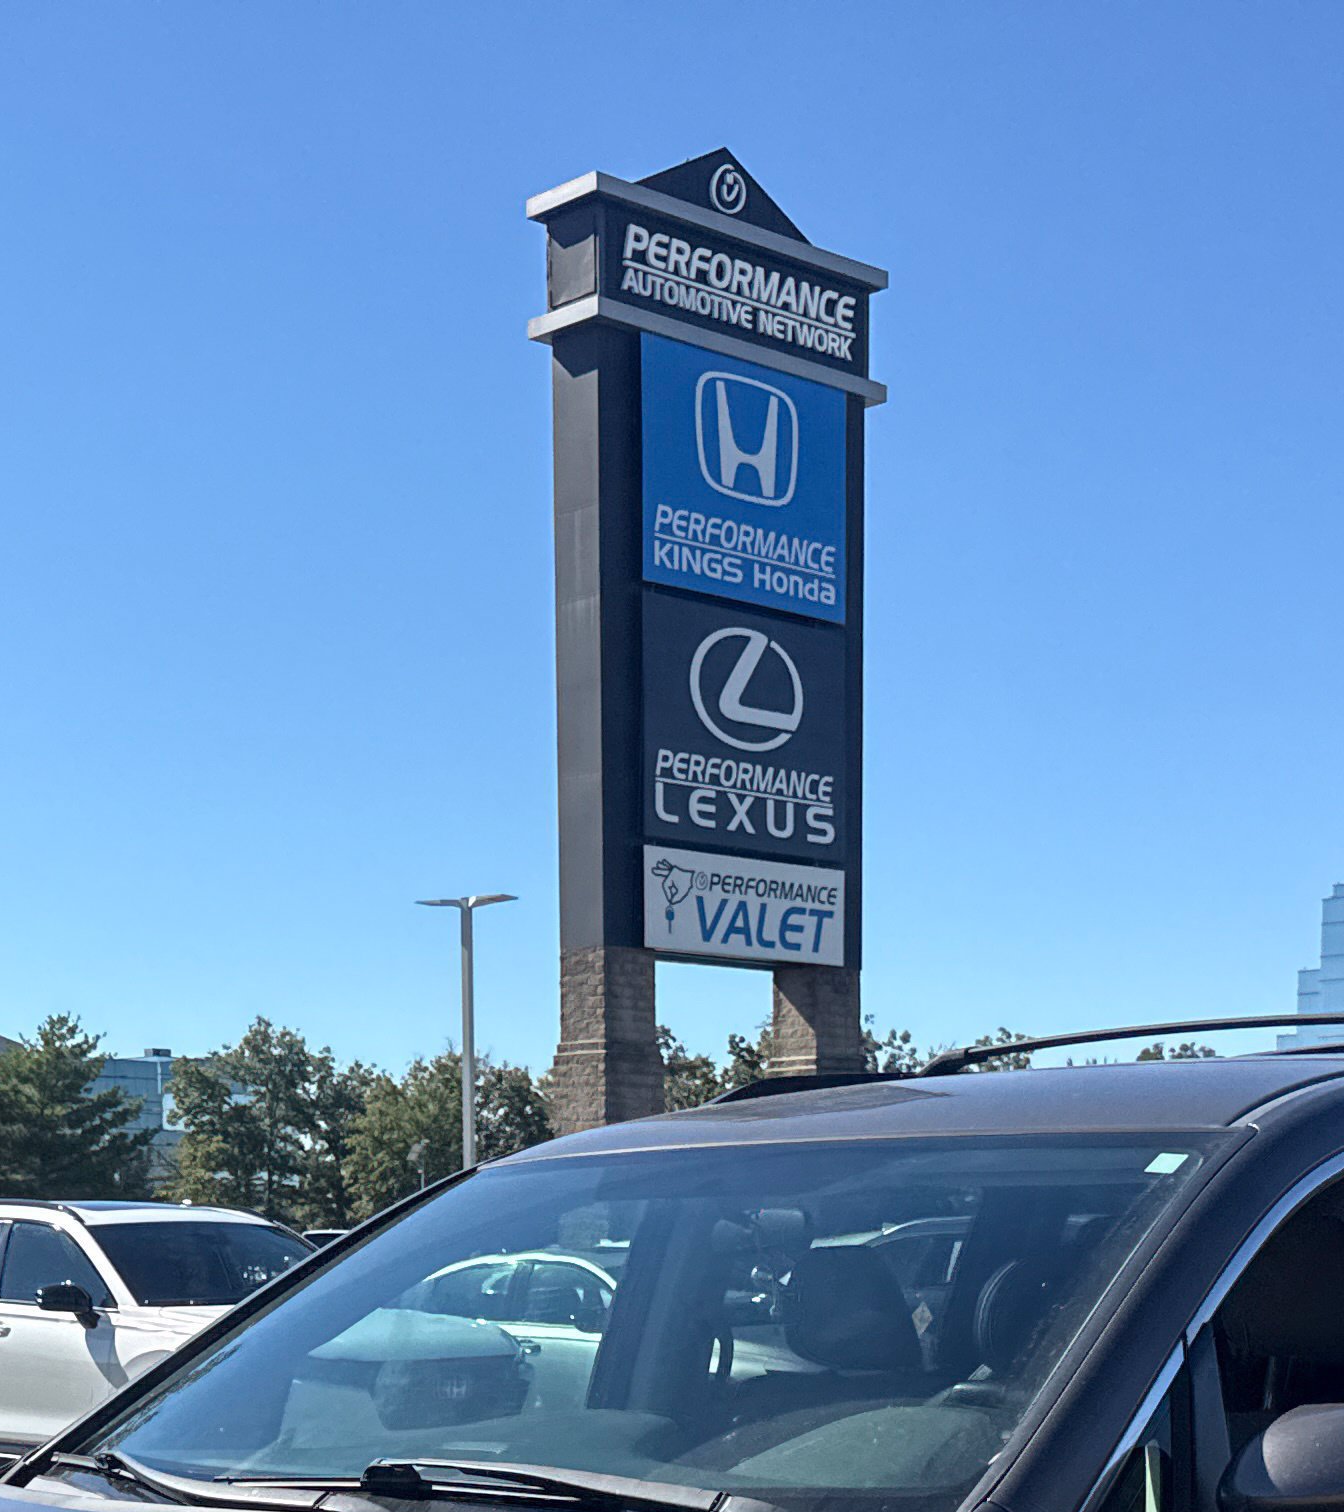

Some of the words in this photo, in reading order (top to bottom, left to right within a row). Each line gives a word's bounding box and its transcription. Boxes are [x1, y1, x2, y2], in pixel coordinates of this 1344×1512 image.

[622, 223, 856, 330] PERFORMANCE
[621, 268, 754, 329] AUTOMOTIVE
[759, 310, 853, 361] NETWORK
[654, 503, 836, 574] PERFORMANCE
[654, 540, 744, 584] KINGS
[754, 563, 836, 605] Honda
[656, 748, 835, 803] PERFORMANCE
[655, 782, 836, 844] LEXUS
[709, 872, 838, 906] PERFORMANCE
[695, 895, 834, 953] VALET
